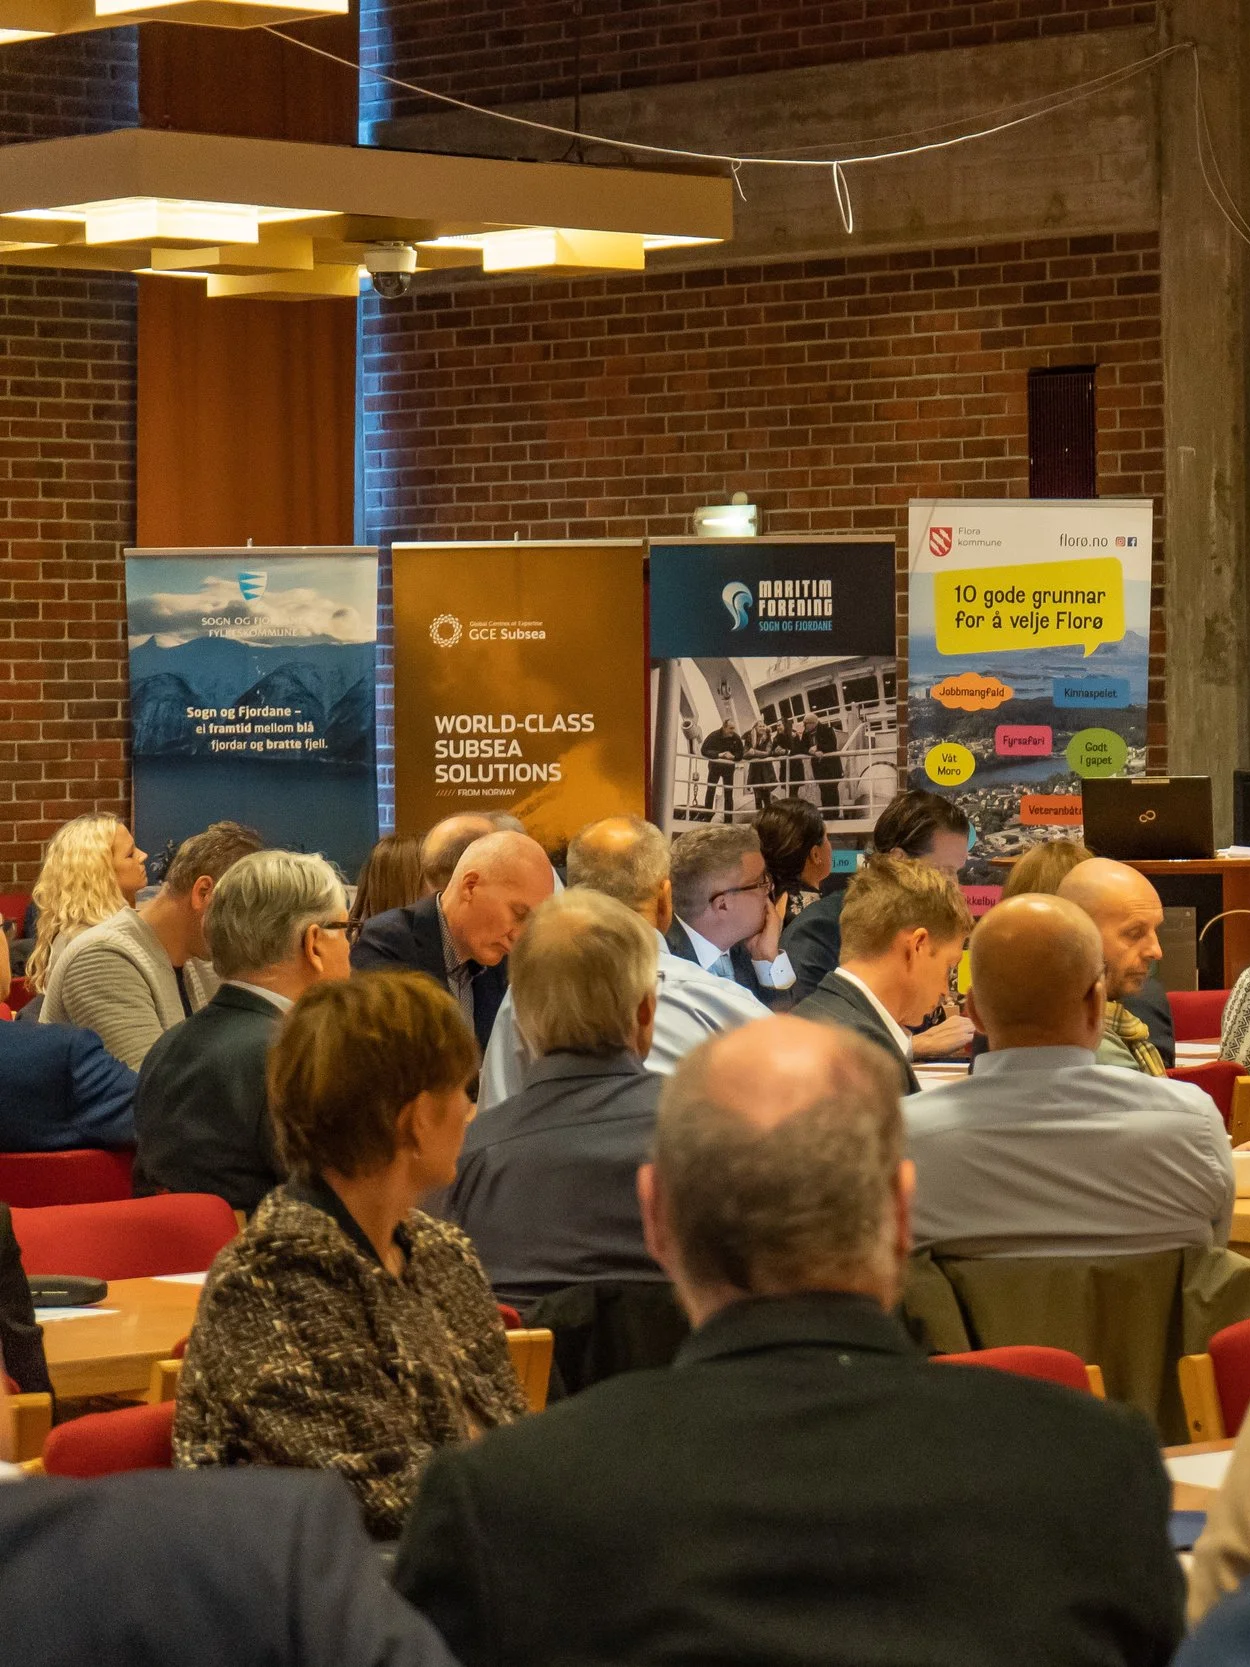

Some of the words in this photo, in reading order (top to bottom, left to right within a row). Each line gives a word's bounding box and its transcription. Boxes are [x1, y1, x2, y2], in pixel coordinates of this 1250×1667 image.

[958, 527, 981, 535] Flora
[957, 538, 1002, 547] kommune
[1059, 533, 1109, 547] florø.no
[758, 579, 832, 598] MARITIM
[954, 584, 977, 603] 10
[983, 585, 1026, 609] gode
[1032, 589, 1106, 609] grunnar
[758, 598, 833, 617] FORENING
[201, 617, 231, 626] SOGN
[234, 616, 251, 625] OG
[254, 617, 303, 626] FJON
[758, 621, 780, 632] SOGN
[781, 620, 793, 631] OG
[795, 620, 833, 631] FJORDANE
[955, 610, 985, 629] for
[992, 610, 1002, 629] å
[1010, 611, 1050, 635] velje
[1056, 611, 1103, 630] Florø
[469, 628, 497, 640] GCE
[500, 628, 546, 640] Subsea
[939, 687, 1005, 699] Jobbmangfald
[1064, 688, 1118, 700] Kinnaspelet
[186, 706, 217, 720] Sogn
[220, 708, 236, 719] og
[238, 705, 291, 719] Fjordane
[195, 723, 206, 734] ei
[208, 722, 252, 734] framtid
[254, 722, 294, 733] mellom
[296, 721, 314, 733] blå
[434, 713, 595, 734] WORLD-CLASS
[211, 739, 247, 752] fjordar
[250, 741, 264, 752] og
[266, 739, 302, 749] bratte
[304, 739, 328, 751] fjell.
[1003, 735, 1045, 748] Fyrsafari
[1085, 741, 1109, 752] Godt
[434, 739, 523, 759] SUBSEA
[941, 753, 957, 763] Våt
[1085, 755, 1113, 767] gapet
[434, 763, 562, 783] SOLUTIONS
[937, 766, 961, 776] Moro
[457, 788, 481, 797] FROM
[481, 787, 516, 796] NORWAY
[965, 896, 996, 907] kkelby
